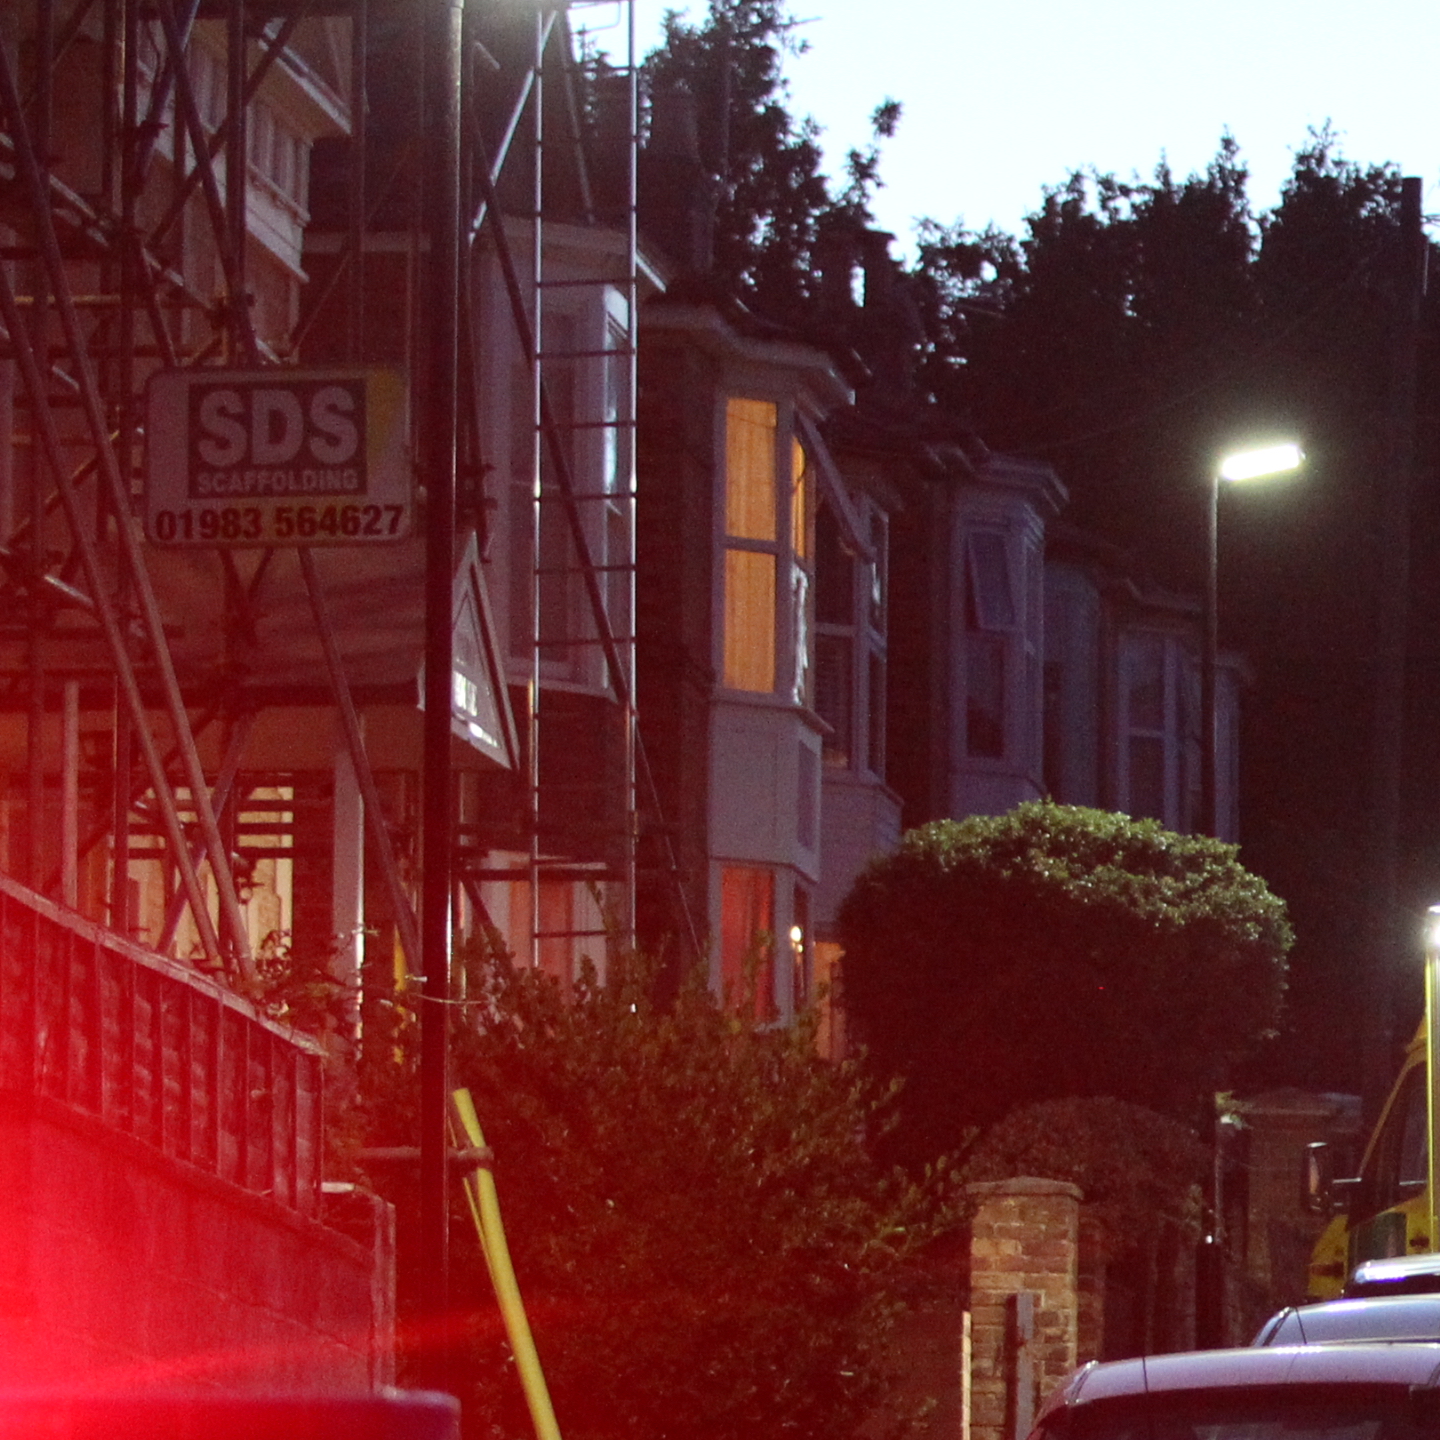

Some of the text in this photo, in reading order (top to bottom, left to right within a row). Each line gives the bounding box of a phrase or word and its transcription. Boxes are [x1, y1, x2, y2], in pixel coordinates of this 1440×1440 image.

[198, 385, 359, 468] SDS
[198, 468, 358, 494] SCAFFOLDING
[155, 504, 404, 541] 01983 564627
